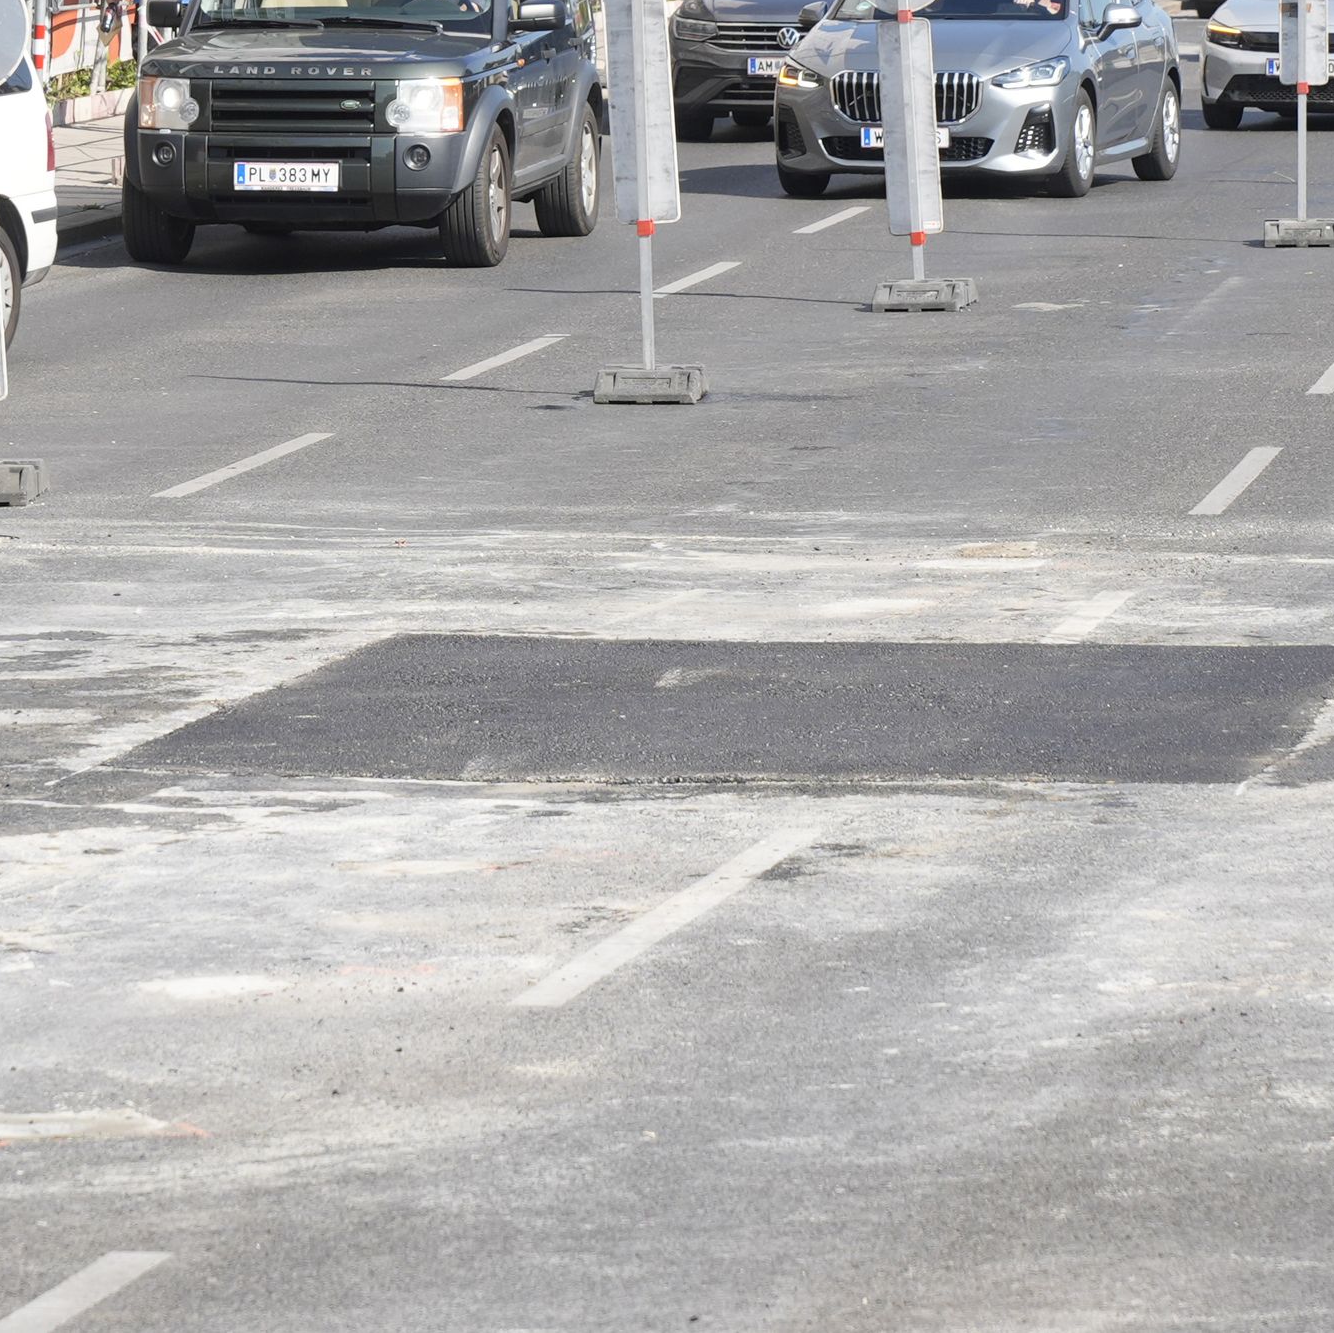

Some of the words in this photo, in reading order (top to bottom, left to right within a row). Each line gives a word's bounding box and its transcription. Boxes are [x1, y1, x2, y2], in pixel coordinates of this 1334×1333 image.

[213, 66, 276, 76] LAND
[290, 67, 373, 77] ROVER
[249, 167, 266, 182] PL
